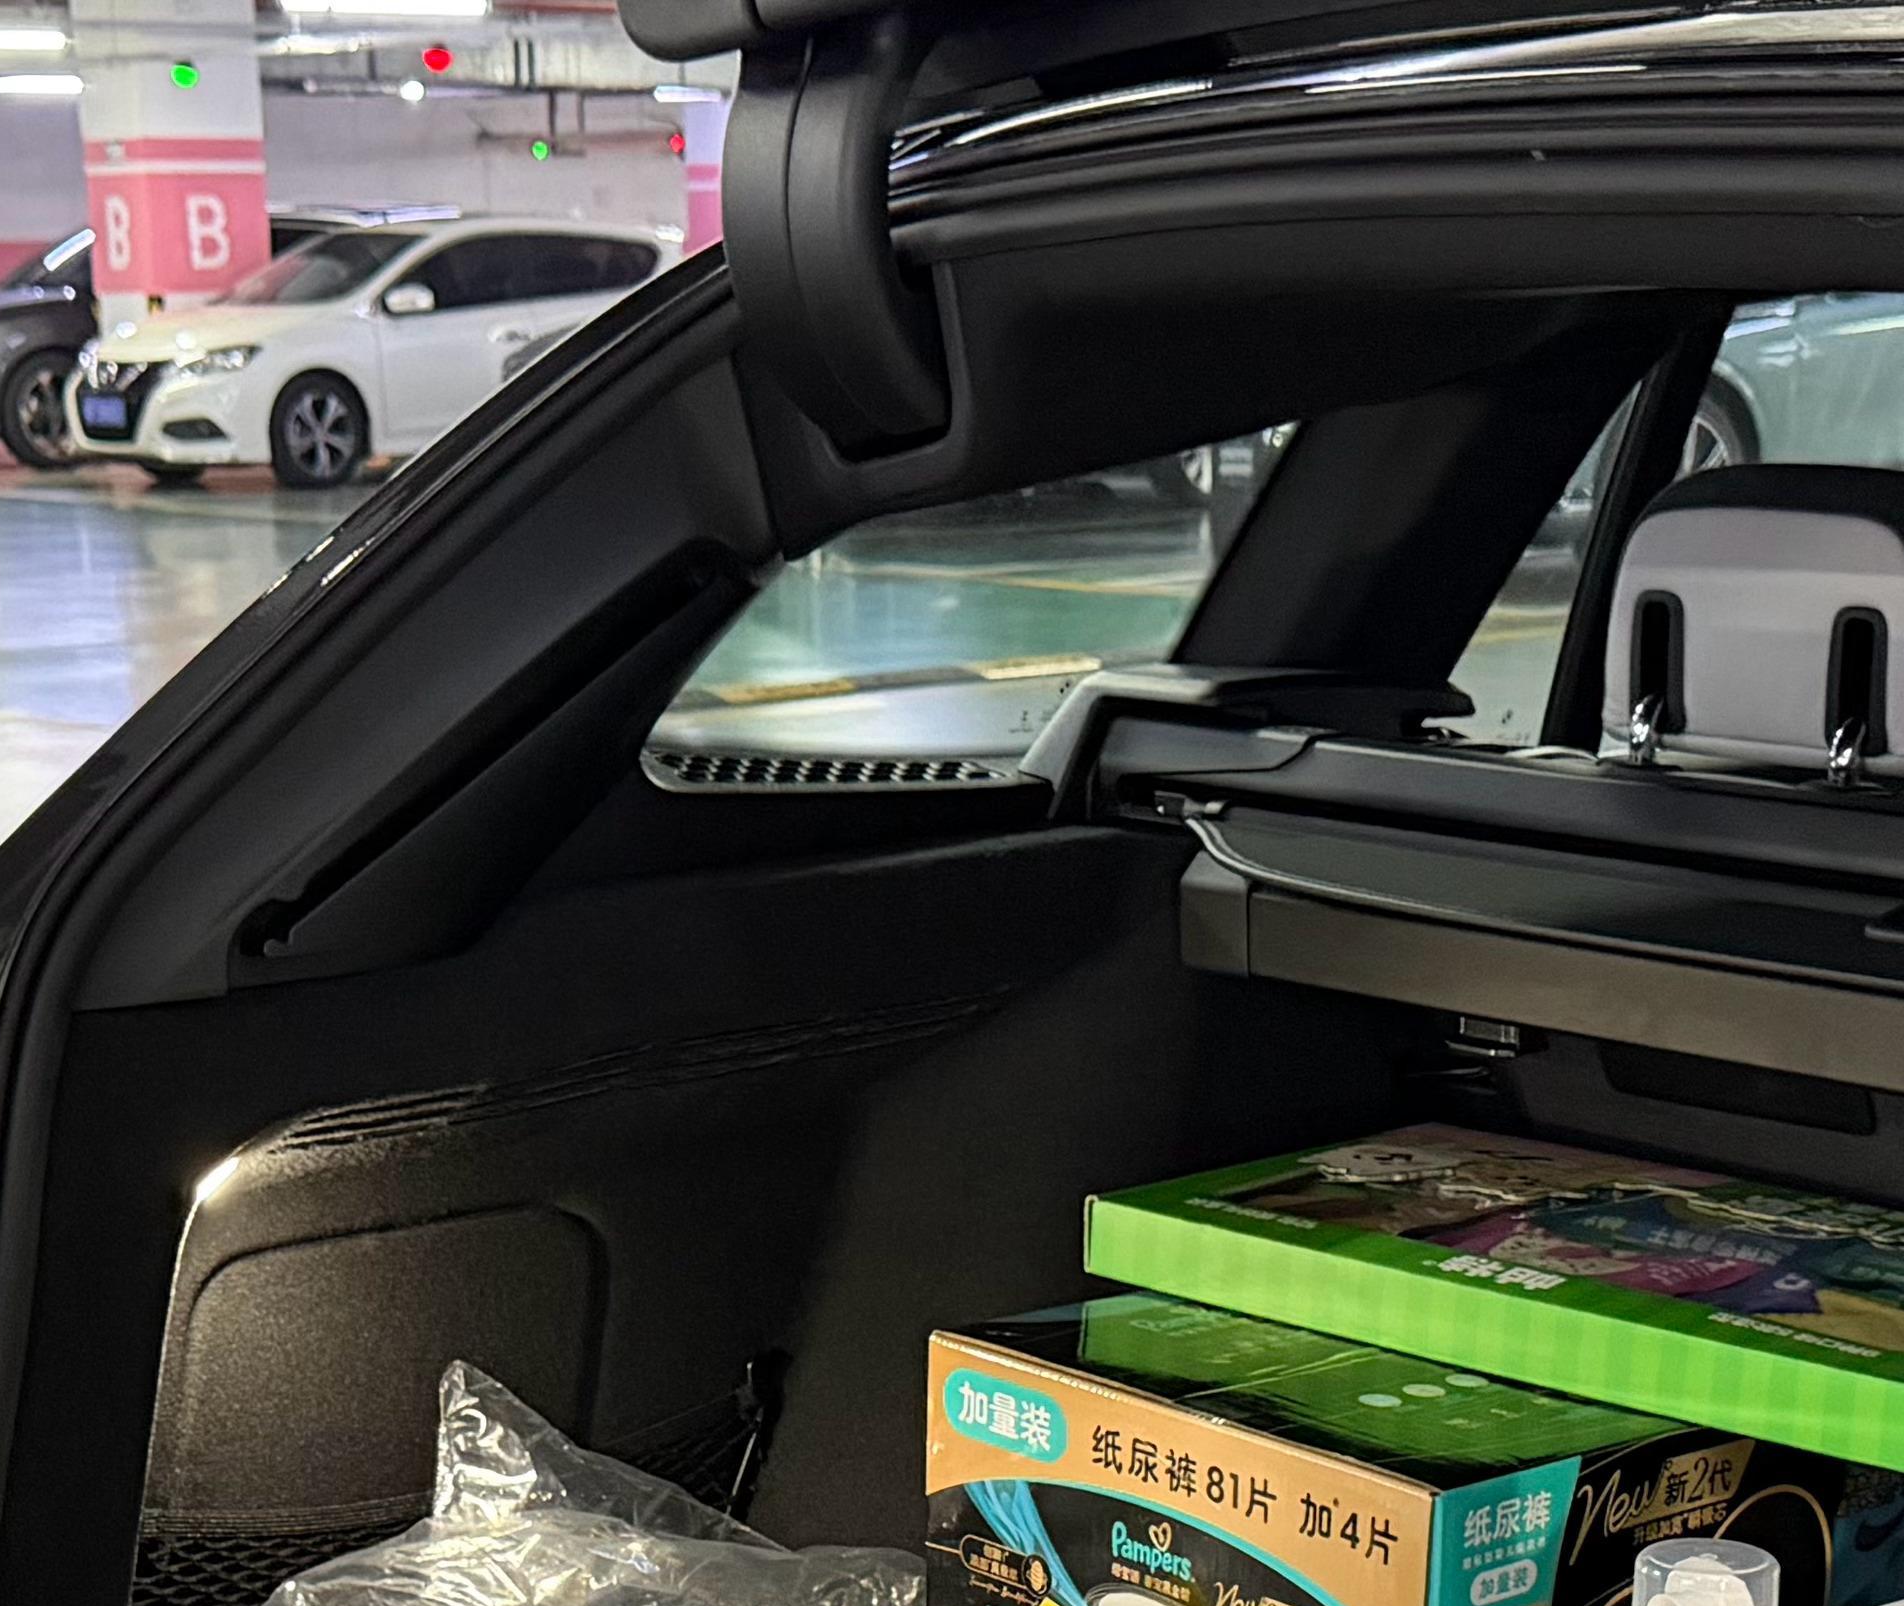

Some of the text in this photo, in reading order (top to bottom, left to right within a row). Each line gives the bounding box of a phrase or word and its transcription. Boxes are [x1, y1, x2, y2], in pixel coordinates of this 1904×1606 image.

[105, 194, 132, 272] B
[186, 193, 230, 271] B
[958, 1381, 1052, 1452] 加量装
[1111, 1521, 1194, 1582] Pampers
[1464, 1490, 1552, 1548] 纸尿裤
